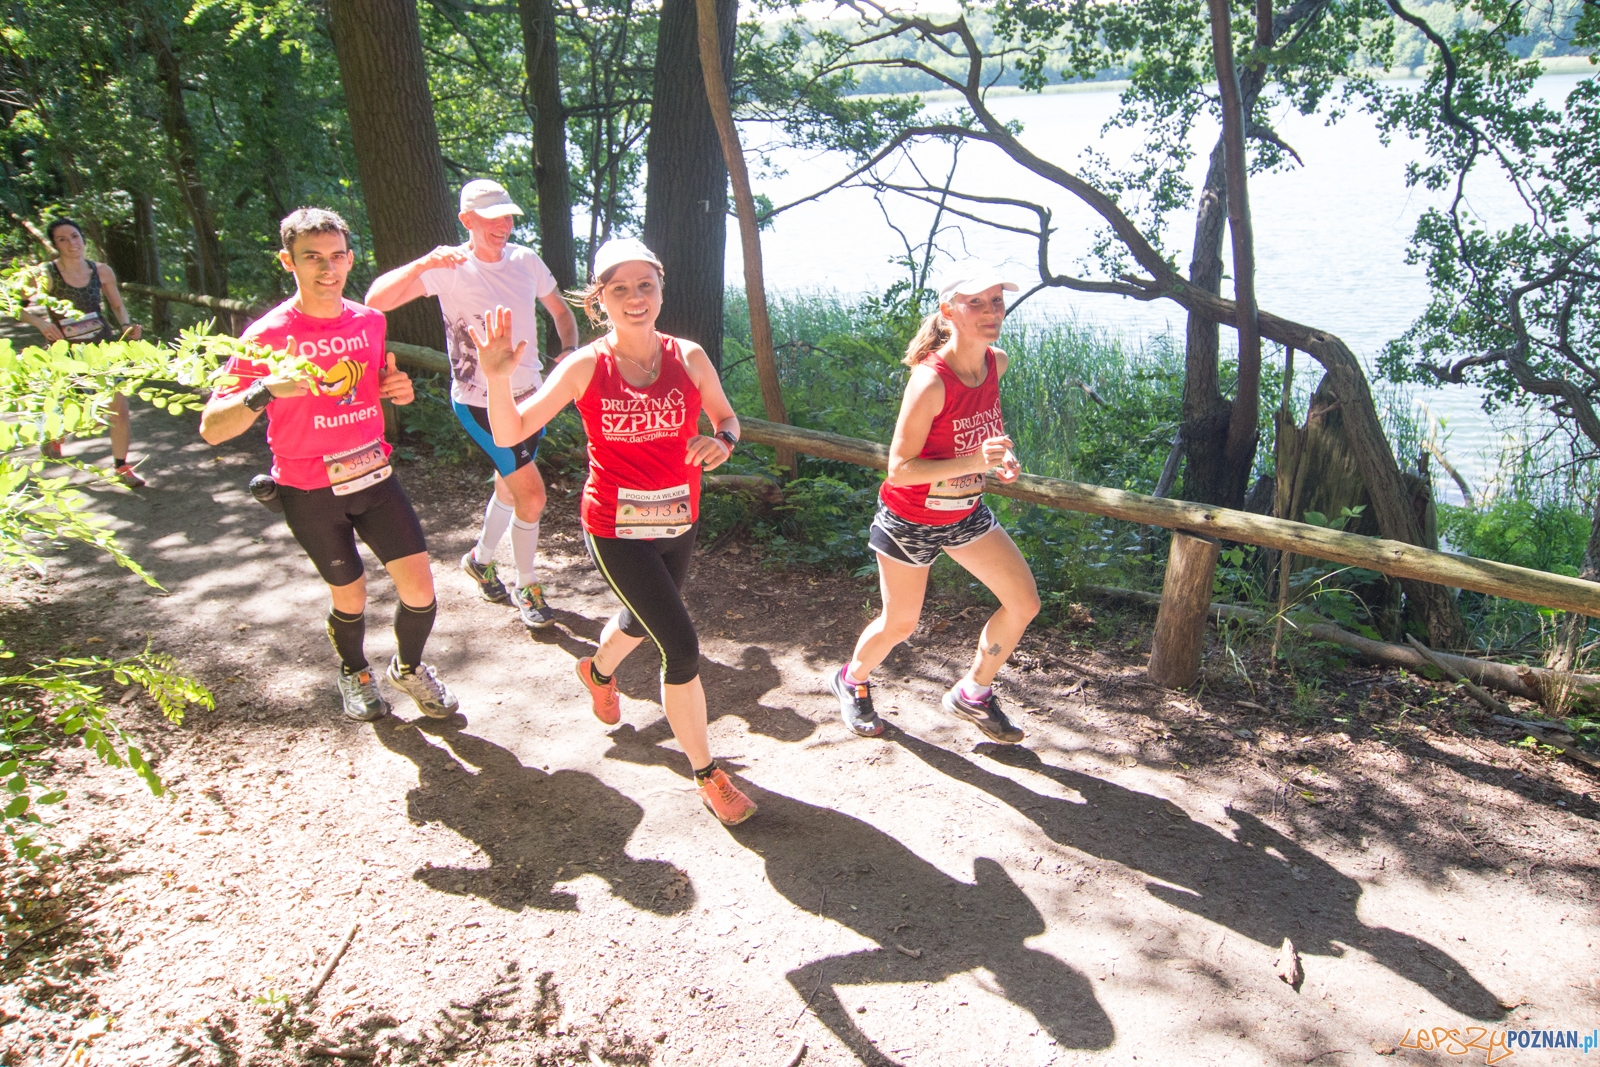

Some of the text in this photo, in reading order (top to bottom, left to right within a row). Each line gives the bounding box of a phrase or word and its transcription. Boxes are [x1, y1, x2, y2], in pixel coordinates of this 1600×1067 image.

[313, 404, 378, 430] Runners
[601, 408, 687, 433] SZPIKU
[952, 407, 1000, 432] DRUŻYNA
[604, 430, 680, 444] www.darszpiku.pl
[348, 452, 371, 471] 343
[640, 503, 672, 518] 313
